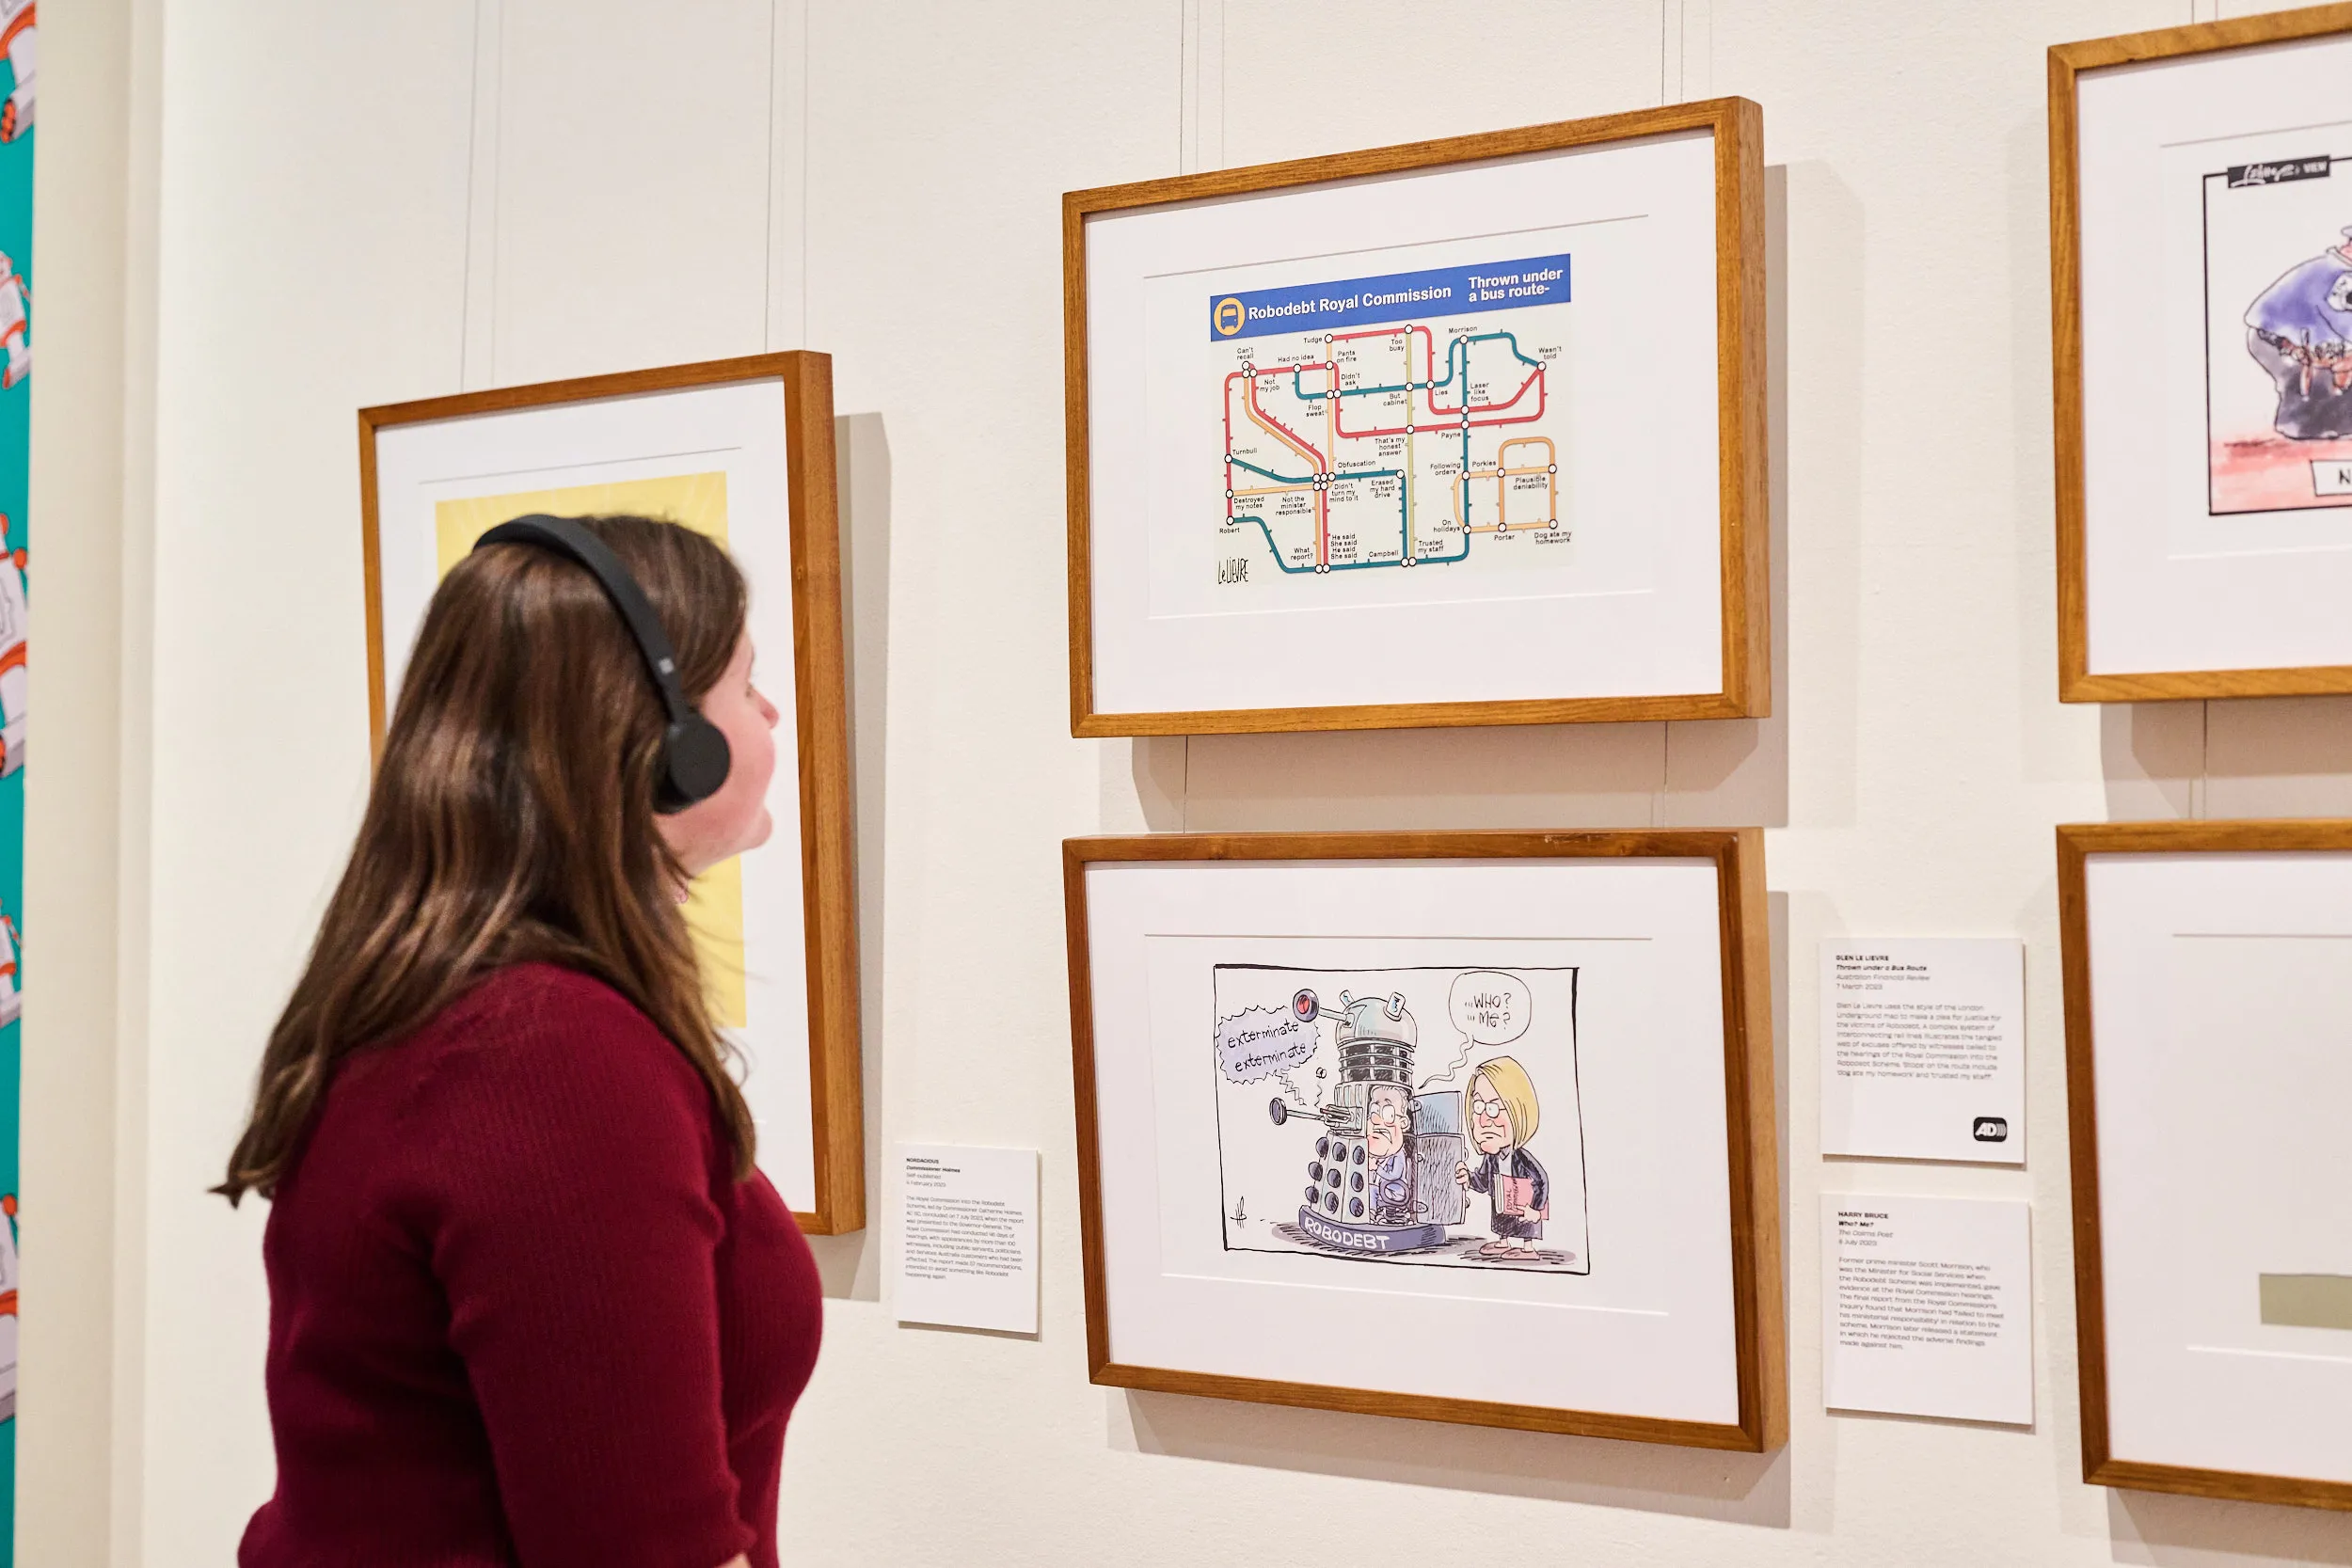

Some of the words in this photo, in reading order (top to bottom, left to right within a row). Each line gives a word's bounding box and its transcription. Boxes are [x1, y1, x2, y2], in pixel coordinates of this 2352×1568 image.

[1469, 275, 1518, 289] Thrown
[1522, 269, 1563, 283] under
[1469, 293, 1477, 303] a
[1480, 287, 1504, 302] bus
[1508, 284, 1550, 298] route-
[1248, 299, 1316, 321] Robodebt
[1319, 295, 1359, 314] Royal
[1362, 286, 1452, 309] Commission
[1338, 460, 1375, 468] Obfuscation
[1228, 1020, 1299, 1050] exterminate
[1234, 1042, 1307, 1072] exterminate
[1304, 1216, 1391, 1250] ROBODEBT
